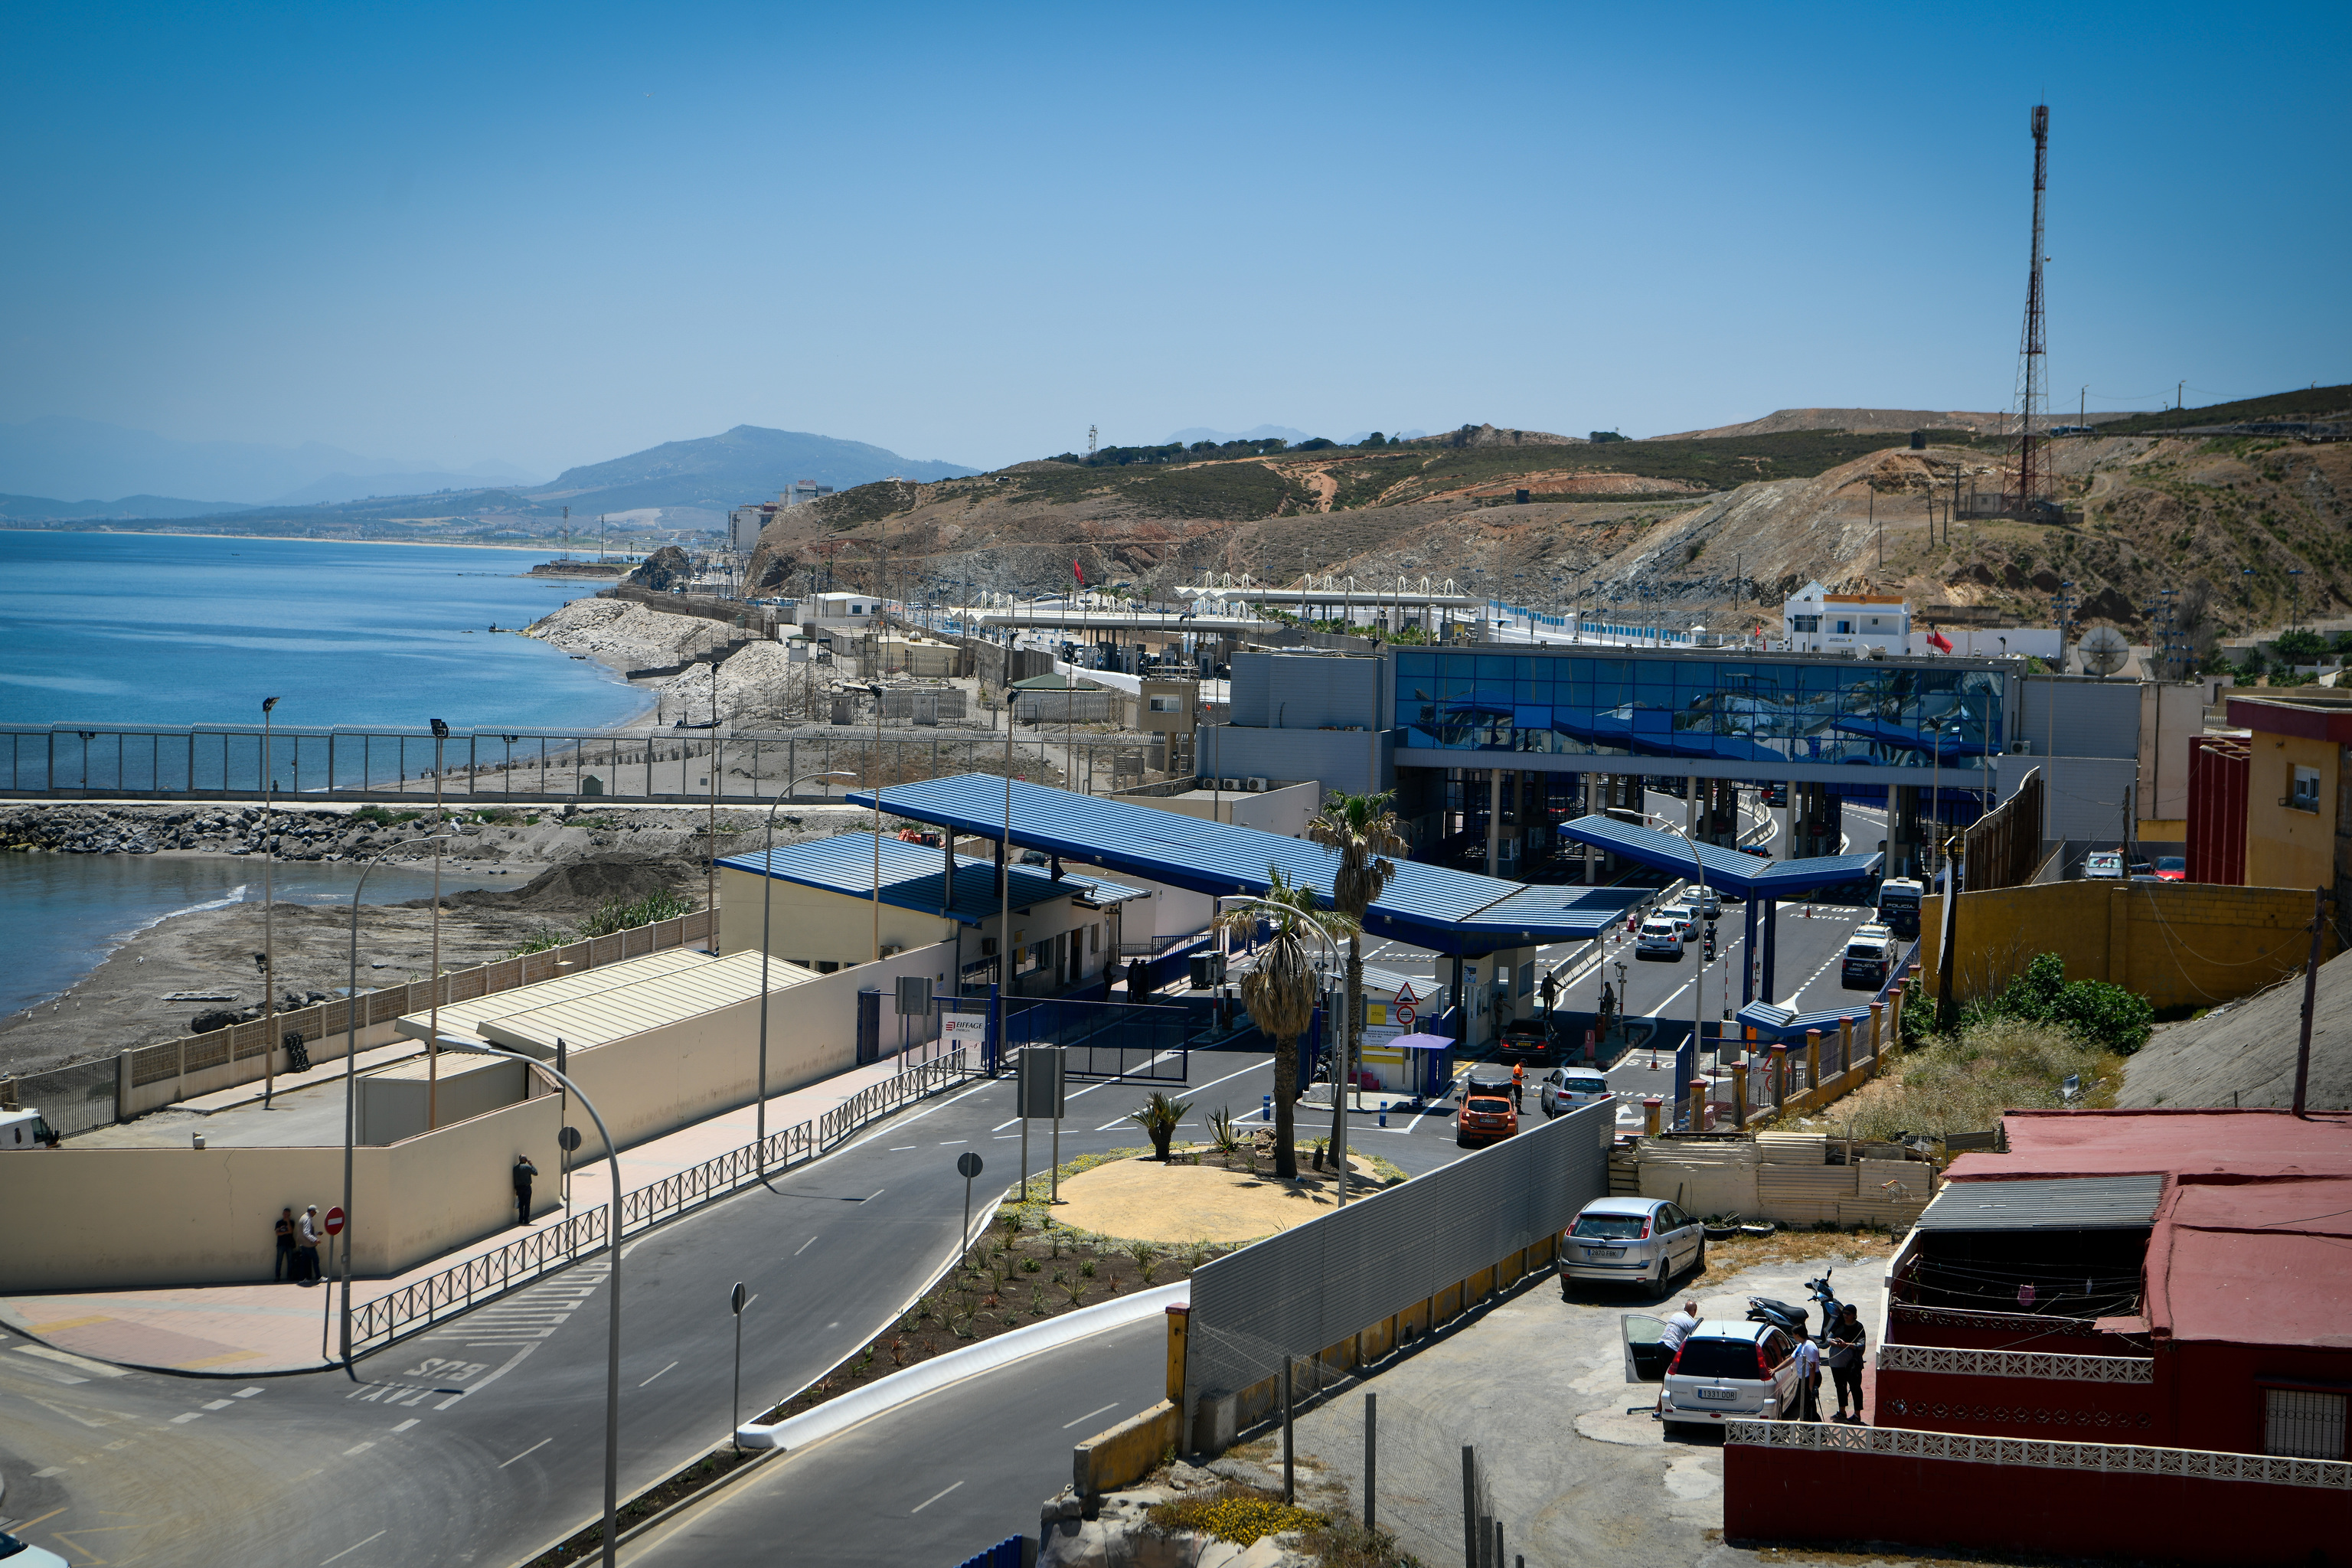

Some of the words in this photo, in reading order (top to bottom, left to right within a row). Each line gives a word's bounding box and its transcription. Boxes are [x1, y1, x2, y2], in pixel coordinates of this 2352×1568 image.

[1800, 905, 1858, 913] STOP
[1789, 913, 1851, 922] FRNTERA
[403, 1357, 491, 1382] BUS
[345, 1380, 440, 1407] TAXI
[1704, 1390, 1720, 1398] 1331
